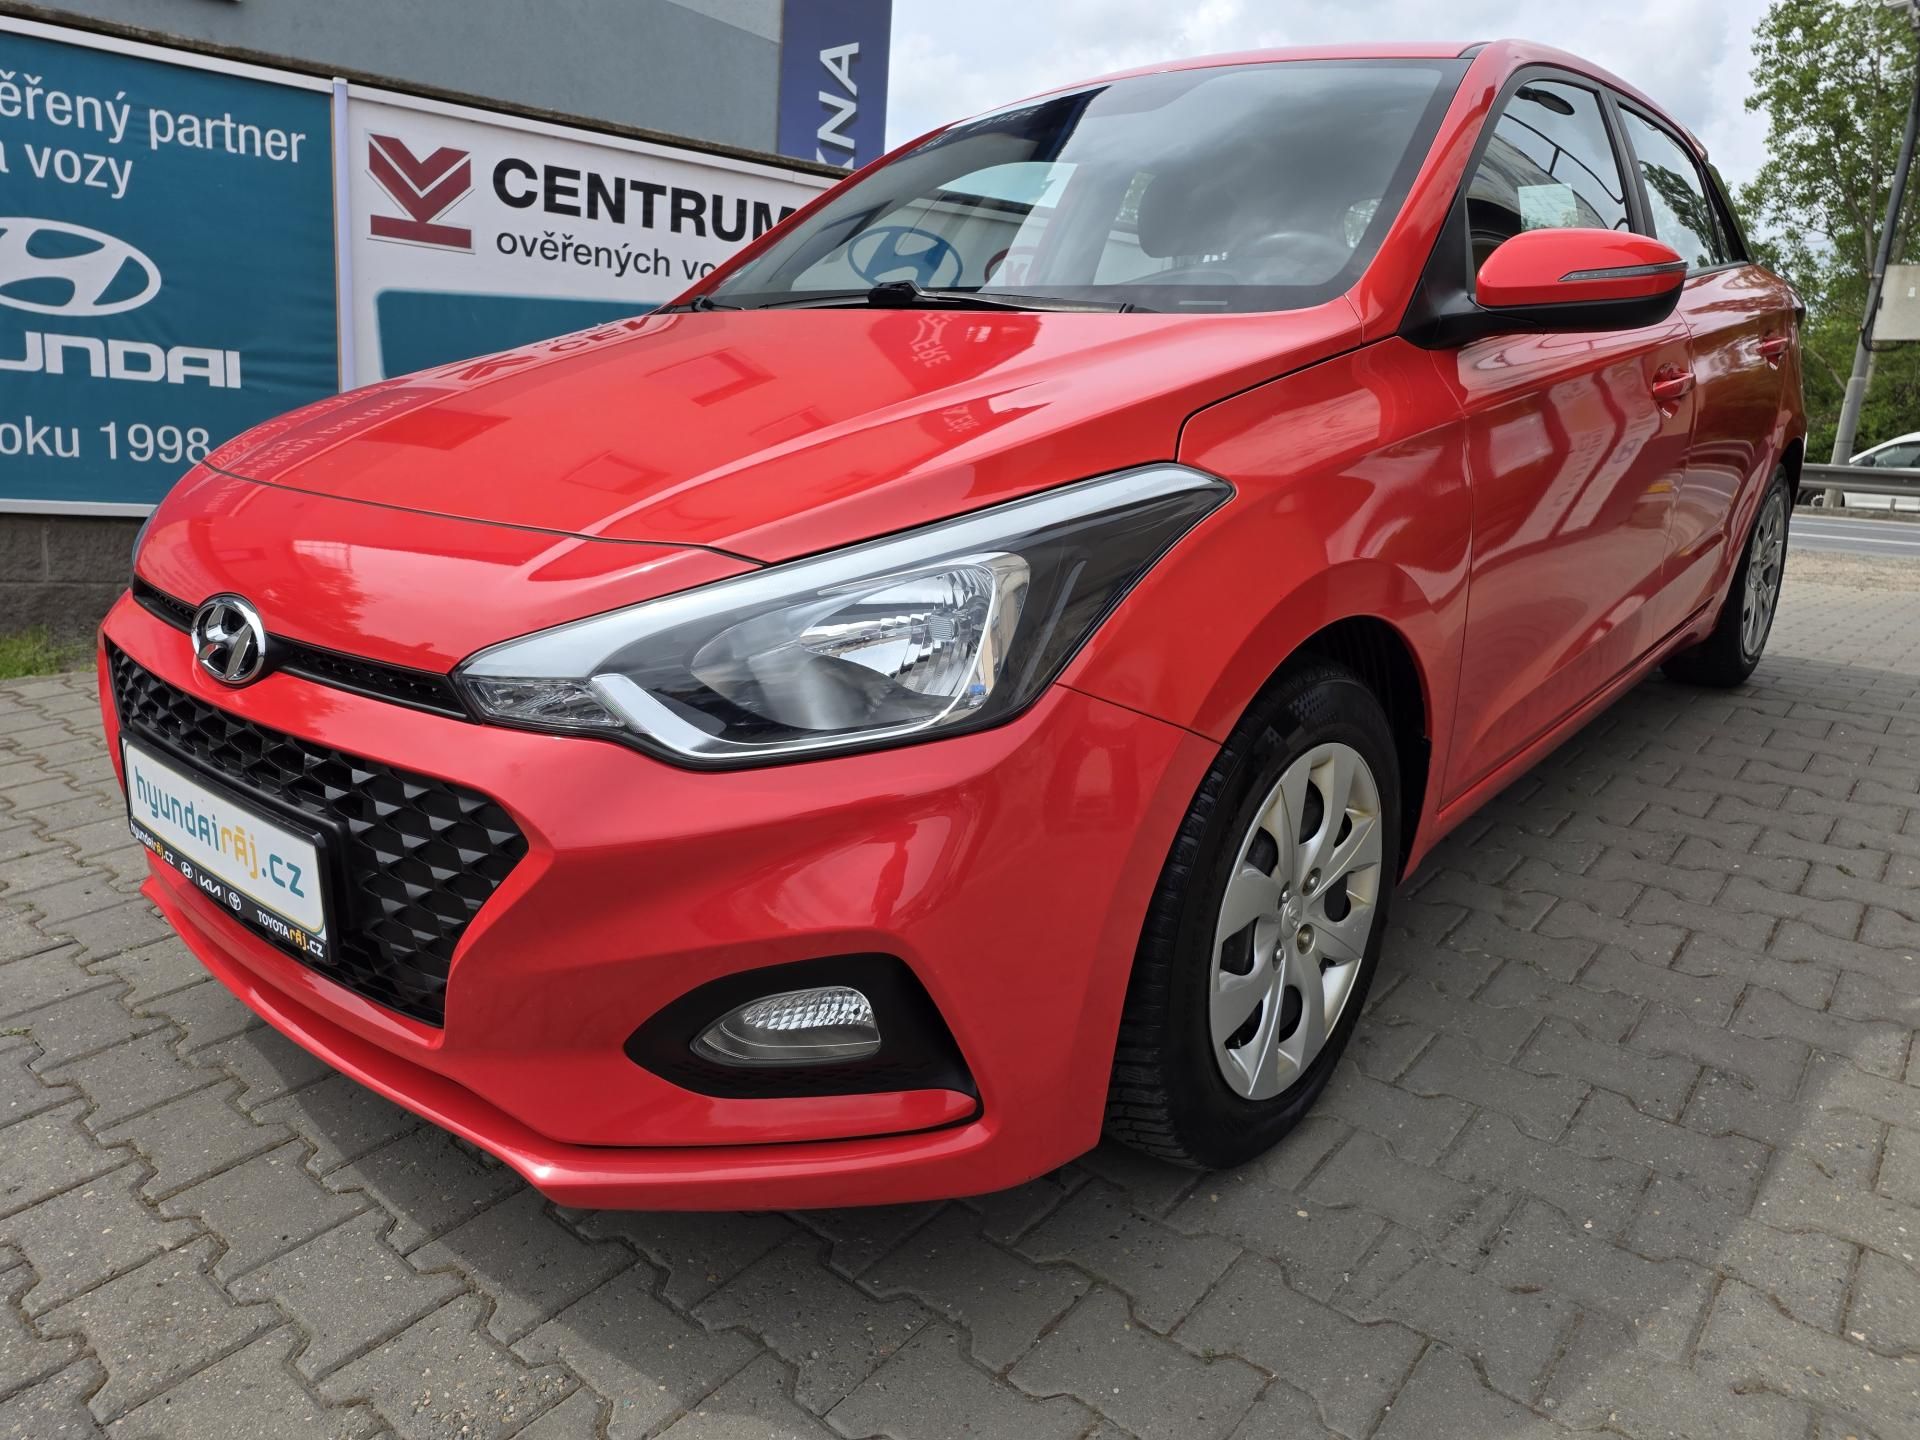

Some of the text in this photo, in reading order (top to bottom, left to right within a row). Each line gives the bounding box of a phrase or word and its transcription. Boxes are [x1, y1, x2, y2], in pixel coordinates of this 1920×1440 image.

[0, 69, 306, 163] ěřený partner
[24, 143, 133, 200] vozy
[492, 158, 797, 243] CENTRUM
[496, 230, 670, 278] ověřených
[0, 416, 80, 458] oku
[100, 421, 211, 464] 1998
